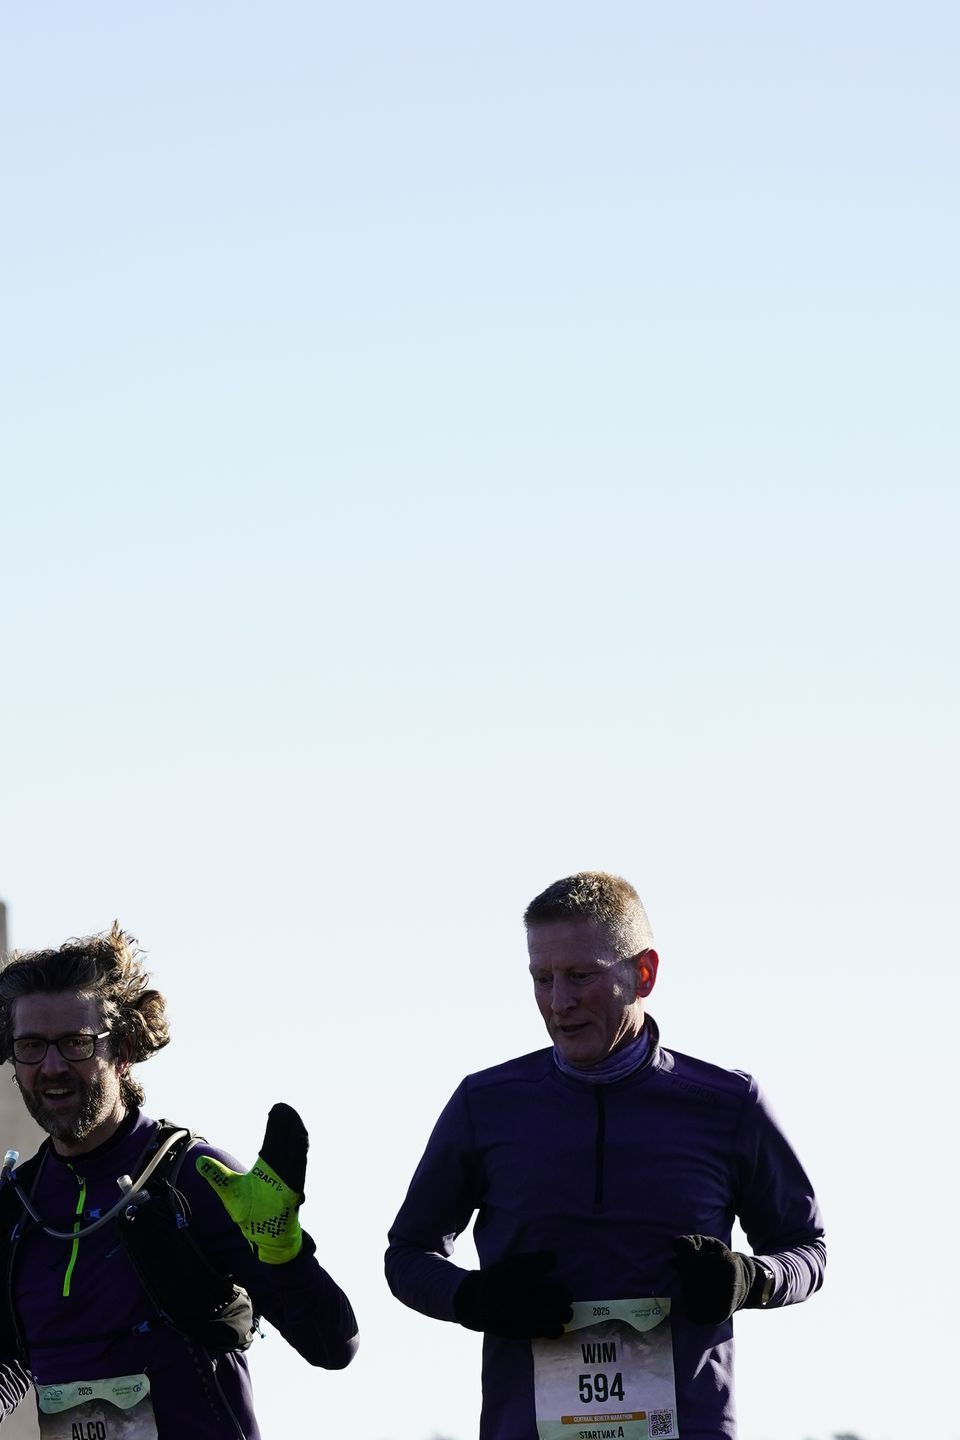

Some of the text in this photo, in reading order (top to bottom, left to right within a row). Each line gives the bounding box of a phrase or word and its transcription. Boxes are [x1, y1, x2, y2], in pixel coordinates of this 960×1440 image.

[252, 1167, 278, 1187] CRAFT
[592, 1306, 610, 1316] 2025
[581, 1342, 617, 1364] WIM
[77, 1386, 93, 1396] 2025
[578, 1372, 625, 1404] 594
[579, 1426, 625, 1440] STARTVAK A
